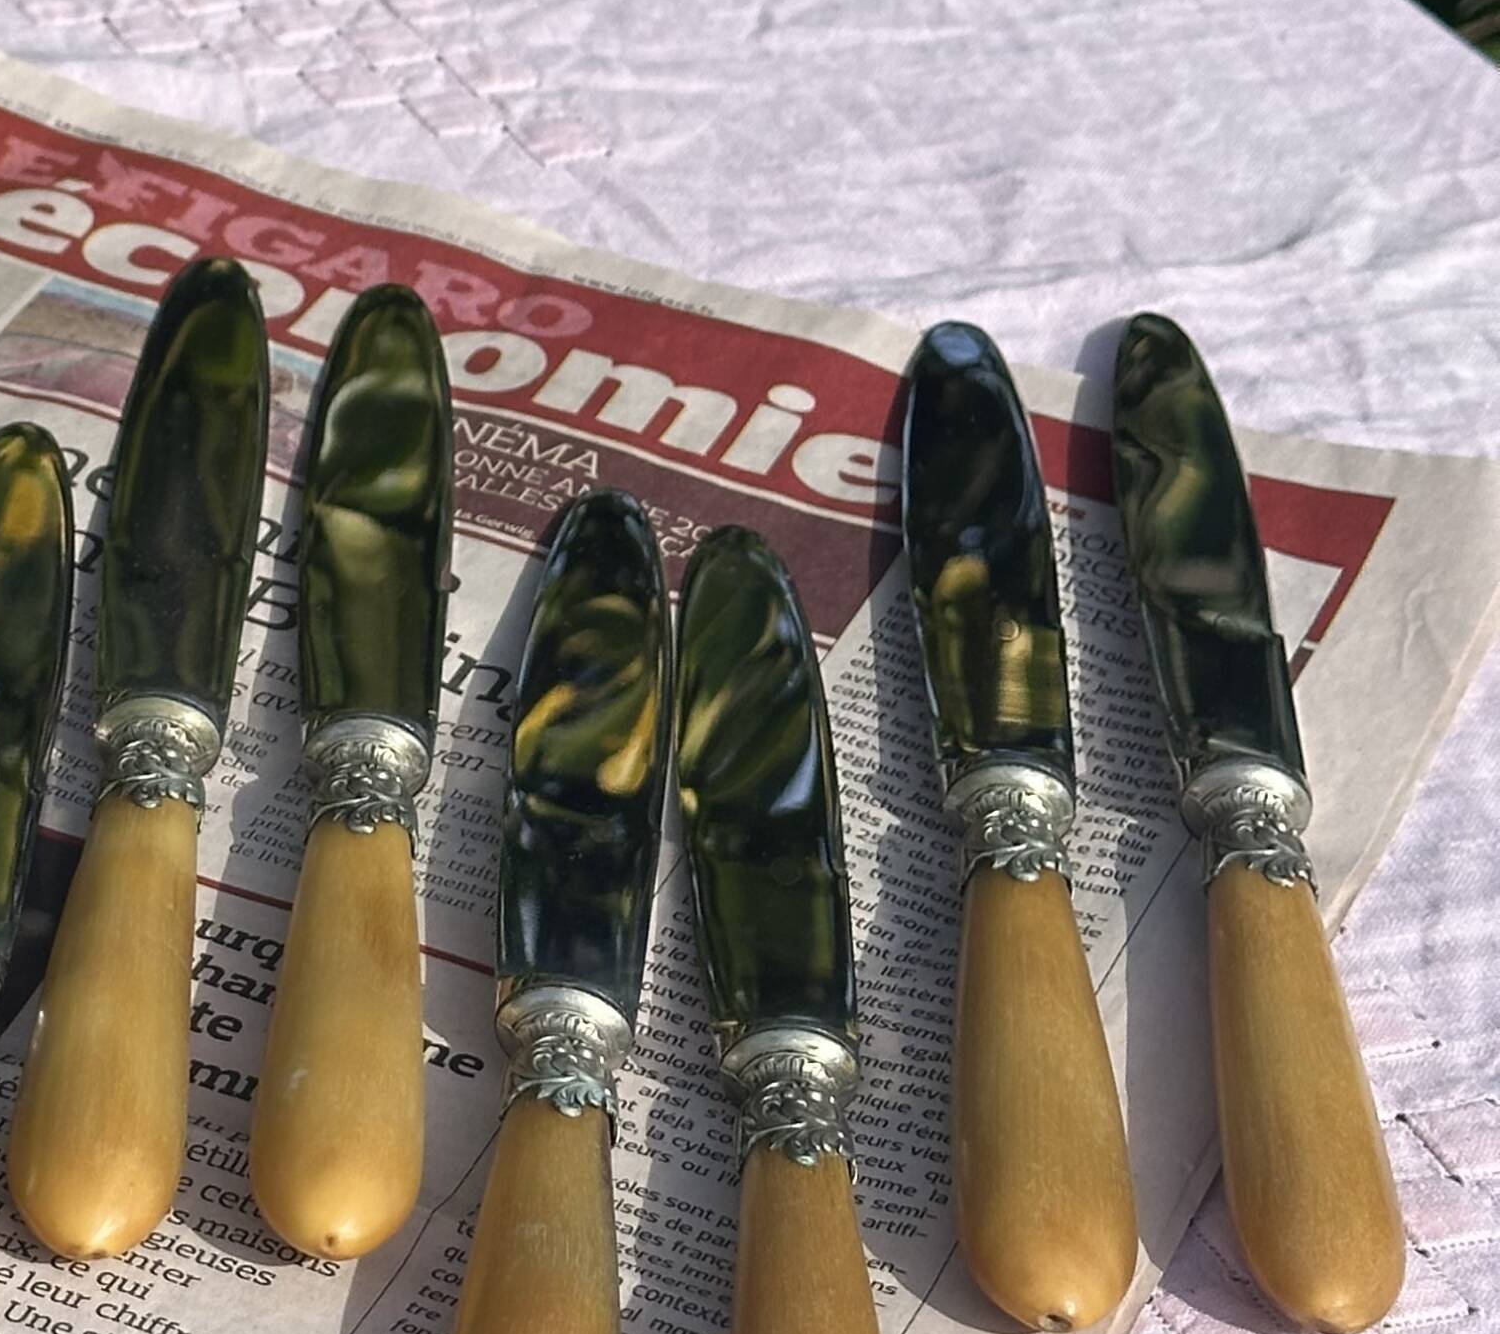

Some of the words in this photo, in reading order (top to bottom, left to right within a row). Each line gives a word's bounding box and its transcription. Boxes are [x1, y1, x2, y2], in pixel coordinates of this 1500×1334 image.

[83, 149, 594, 338] FIGARO
[452, 416, 601, 479] NÉMA
[1085, 861, 1139, 884] pour
[191, 1217, 341, 1277] maisons
[16, 1270, 91, 1309] leur
[96, 1271, 155, 1302] qui
